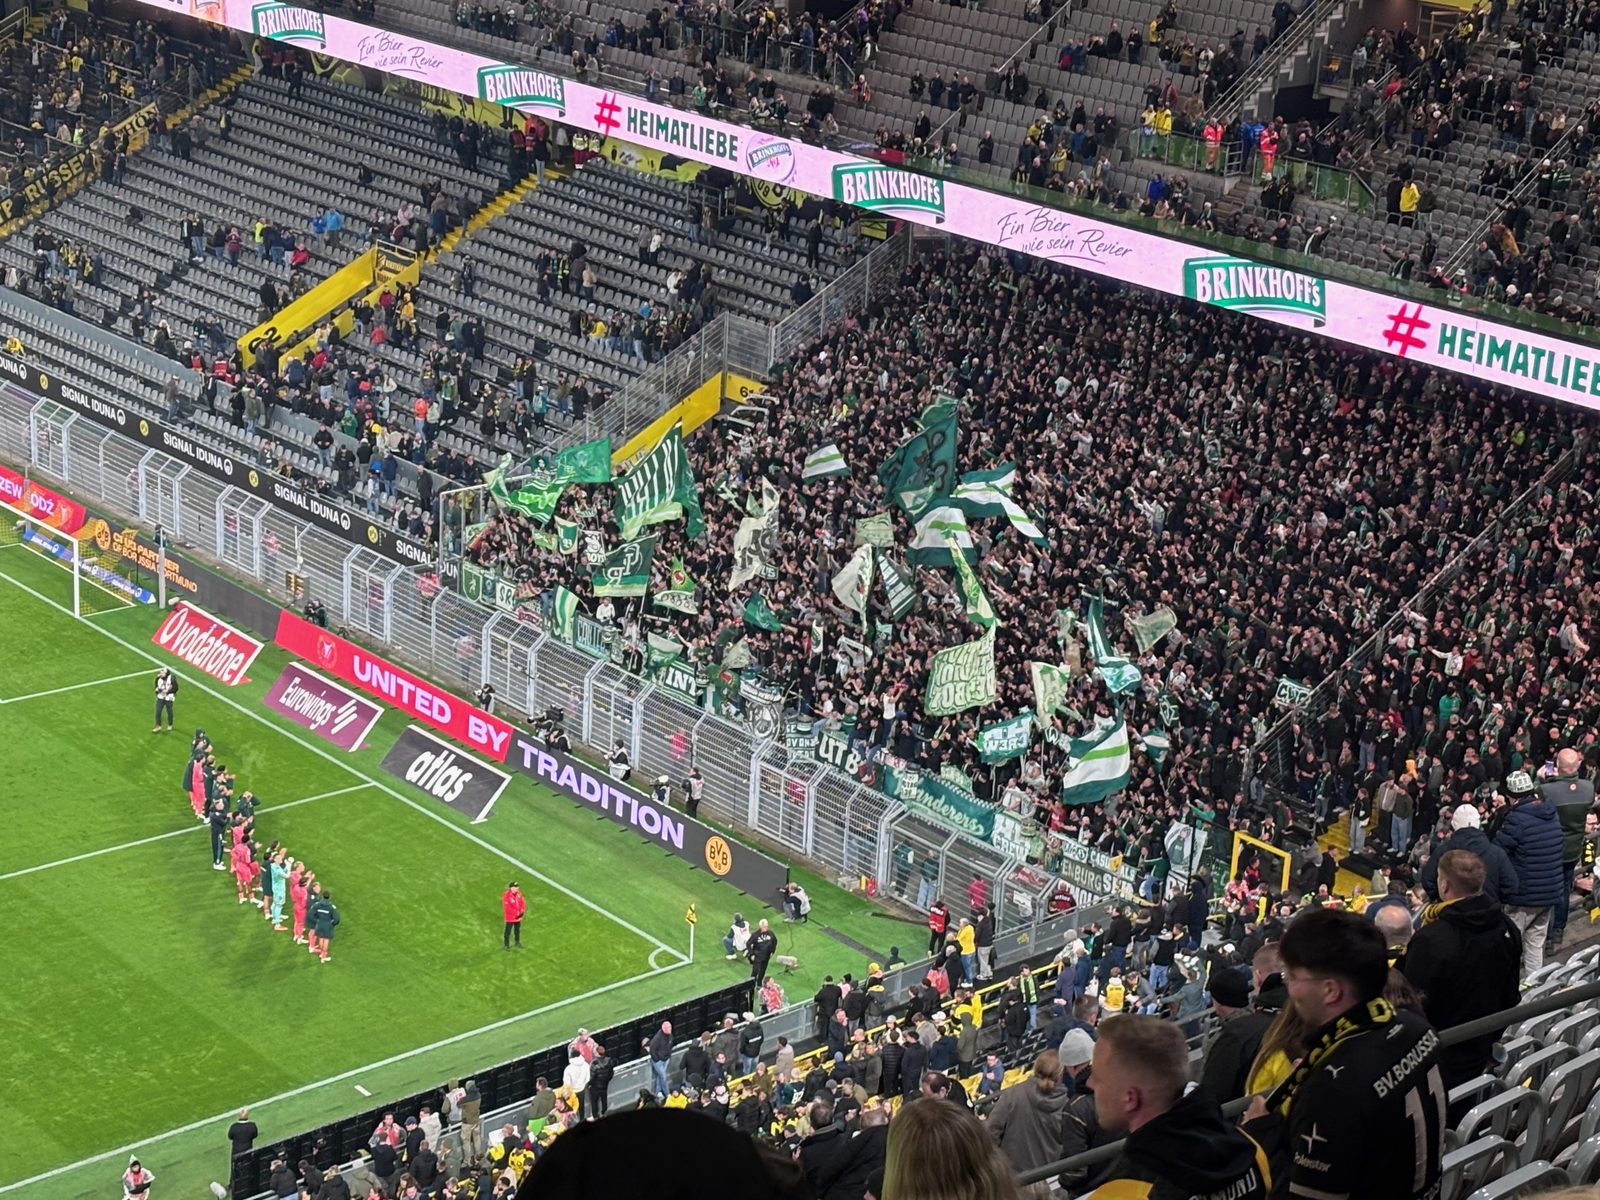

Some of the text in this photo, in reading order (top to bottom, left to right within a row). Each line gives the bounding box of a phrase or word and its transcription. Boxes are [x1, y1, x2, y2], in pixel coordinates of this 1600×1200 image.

[357, 31, 402, 62] Ein Bier
[390, 53, 407, 66] sein
[407, 46, 444, 68] Revier
[997, 207, 1071, 244] Ein Bier
[1046, 234, 1075, 251] sein
[1077, 229, 1133, 258] Revier
[0, 356, 18, 375] DUNA
[61, 384, 116, 421] SIGNAL IDUNA
[163, 431, 223, 472] SIGNAL IDUNA
[0, 475, 22, 499] ZEW
[274, 483, 340, 524] SIGNAL IDUNA
[396, 539, 434, 568] SIGNAL
[170, 621, 245, 682] vodafone
[278, 675, 336, 729] Eurowings
[352, 654, 685, 850] UNITED BY TRADITION
[404, 749, 473, 802] atlas
[1405, 1063, 1447, 1194] 11
